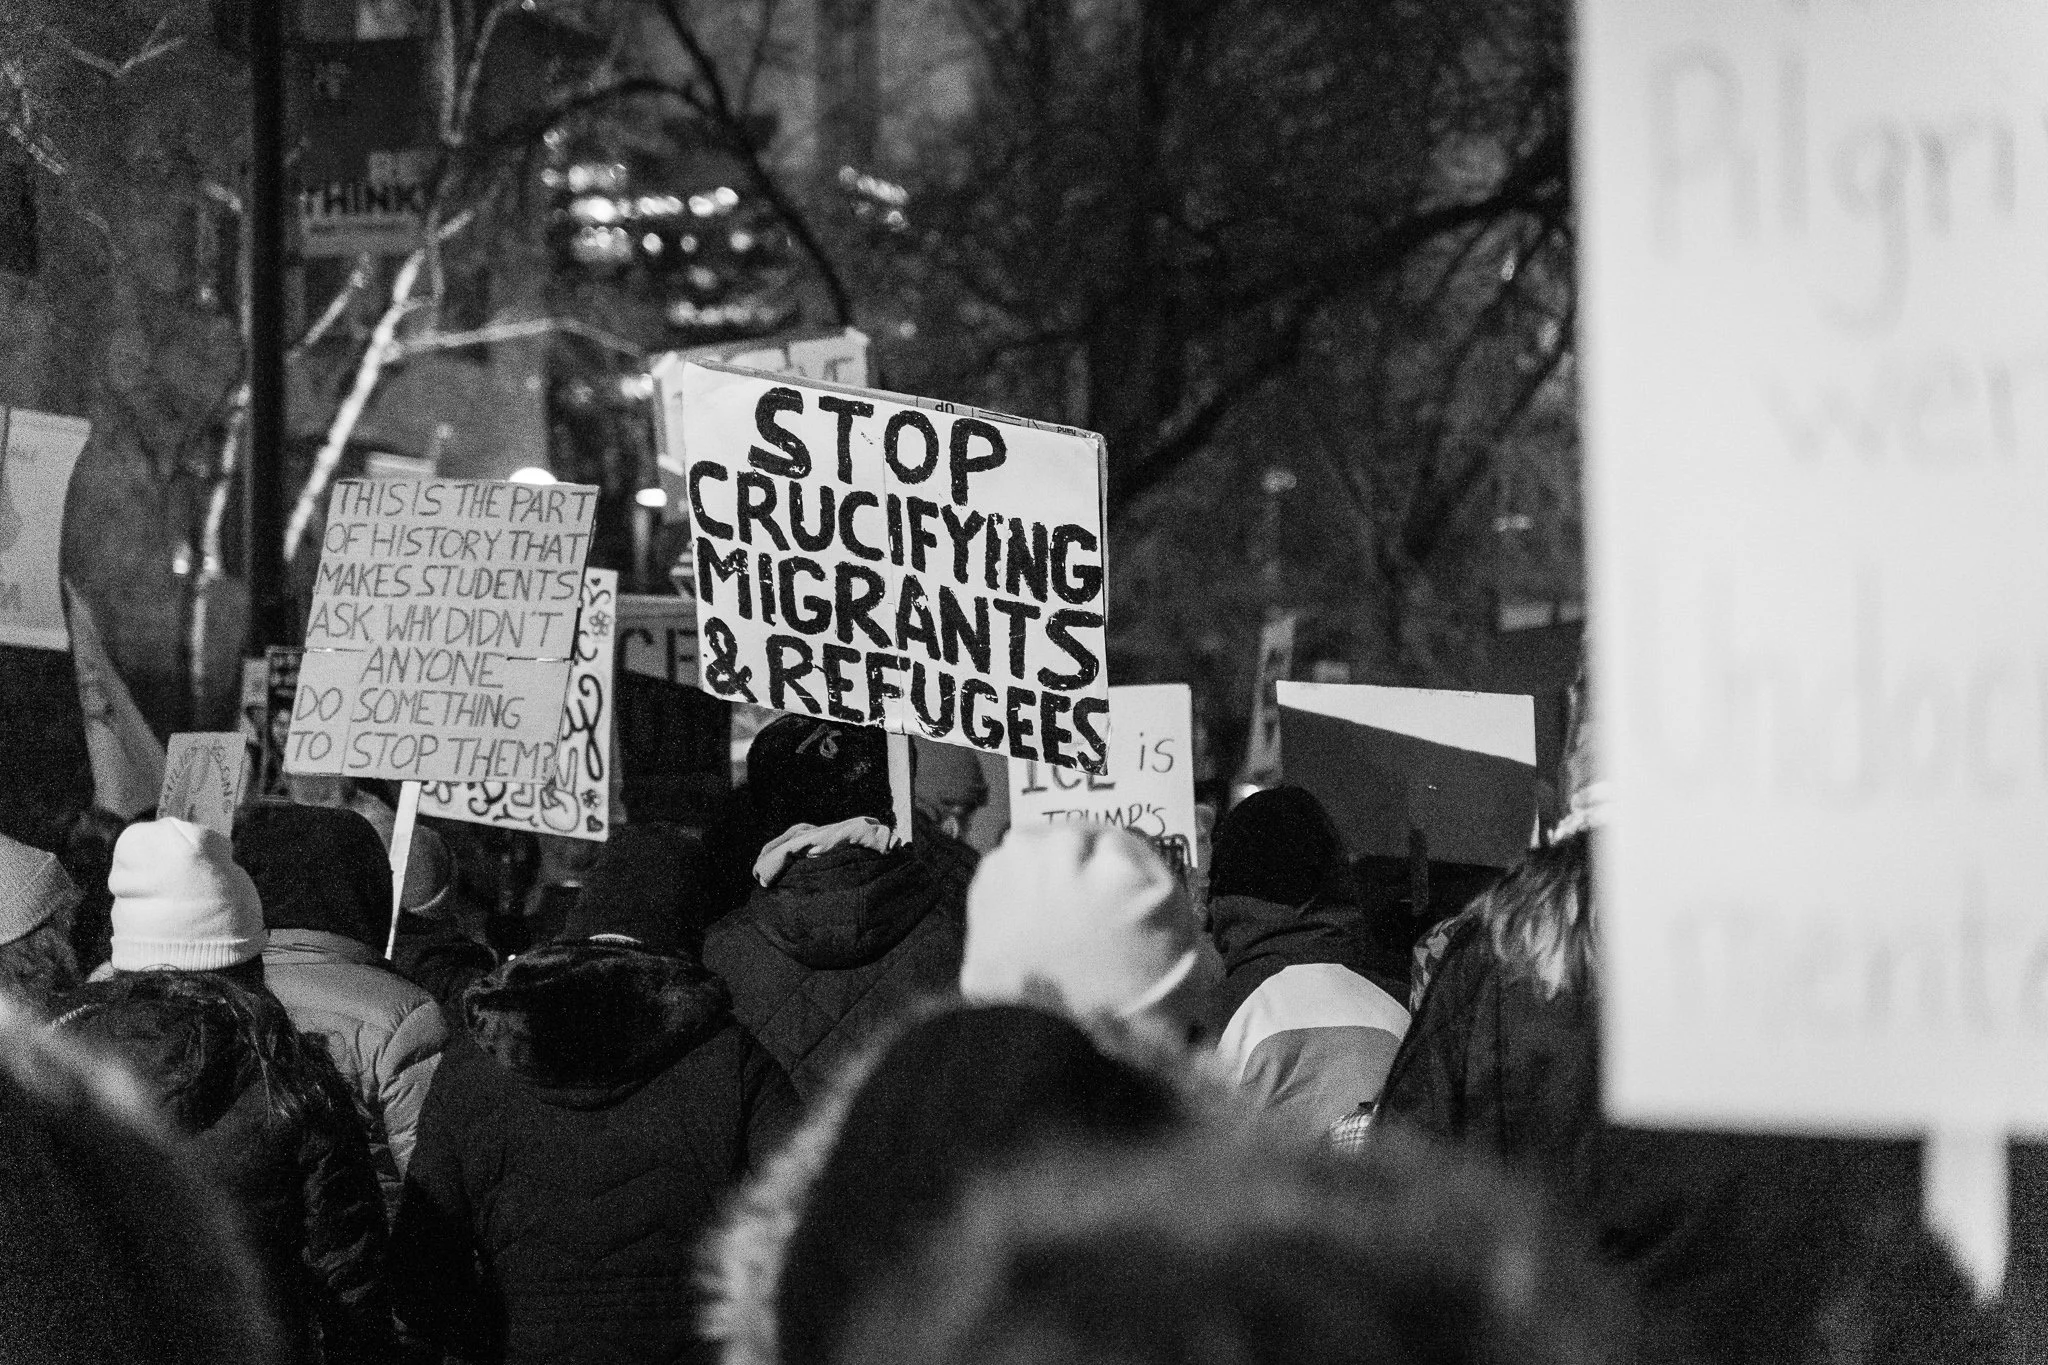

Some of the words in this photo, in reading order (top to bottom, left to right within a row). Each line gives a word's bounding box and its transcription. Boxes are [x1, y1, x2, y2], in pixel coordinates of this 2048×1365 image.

[747, 386, 1008, 506] STOP
[338, 480, 408, 517] THIS
[412, 483, 445, 517] IS
[454, 482, 506, 519] THE
[510, 486, 596, 523] PART
[325, 523, 368, 555] OF
[371, 524, 503, 561] HISTORY
[509, 530, 589, 563] THAT
[689, 460, 1103, 604] CRUCIFYING
[317, 563, 413, 598] MAKES
[415, 565, 579, 601] STUDENTS
[307, 602, 374, 642] ASK
[384, 605, 443, 642] WHY
[696, 536, 1105, 691] MIGRANTS
[360, 646, 505, 690] ANYONE
[295, 685, 343, 721] DO
[352, 687, 525, 730] SOMETHING
[703, 616, 758, 704] &
[765, 633, 1110, 774] REFUGEES
[291, 730, 332, 763] TO
[348, 732, 439, 774] STOP
[448, 736, 557, 780] THEM?
